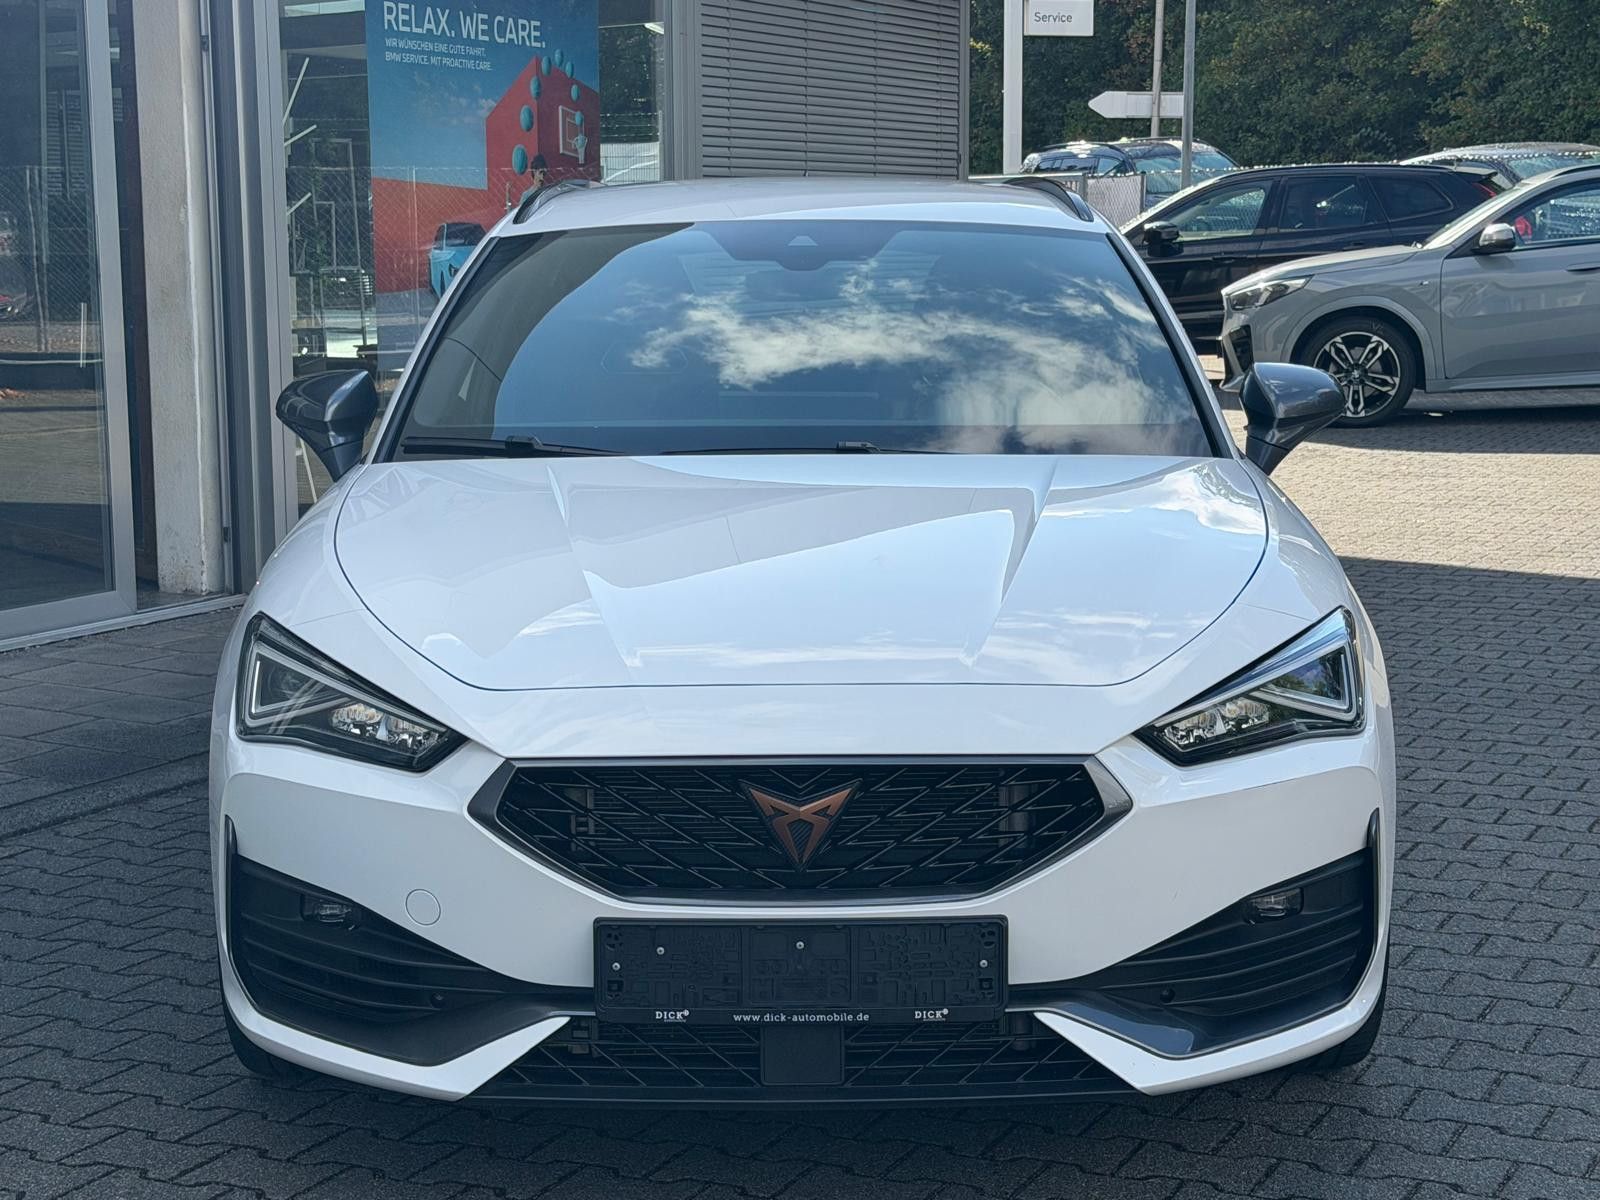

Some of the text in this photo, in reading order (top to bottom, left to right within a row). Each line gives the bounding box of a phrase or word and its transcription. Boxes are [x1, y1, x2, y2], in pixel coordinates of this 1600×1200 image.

[1034, 12, 1073, 23] Service
[384, 1, 546, 48] RELAX. WE CARE.
[385, 37, 398, 48] WIR
[434, 43, 449, 53] EINE
[449, 44, 465, 55] GUTE
[385, 51, 401, 62] BMW
[431, 56, 442, 65] MIT
[442, 57, 476, 70] PROACTIVE
[655, 1010, 685, 1020] DICK
[733, 1013, 869, 1022] www.dick-automobile.de
[914, 1009, 944, 1019] DICK
